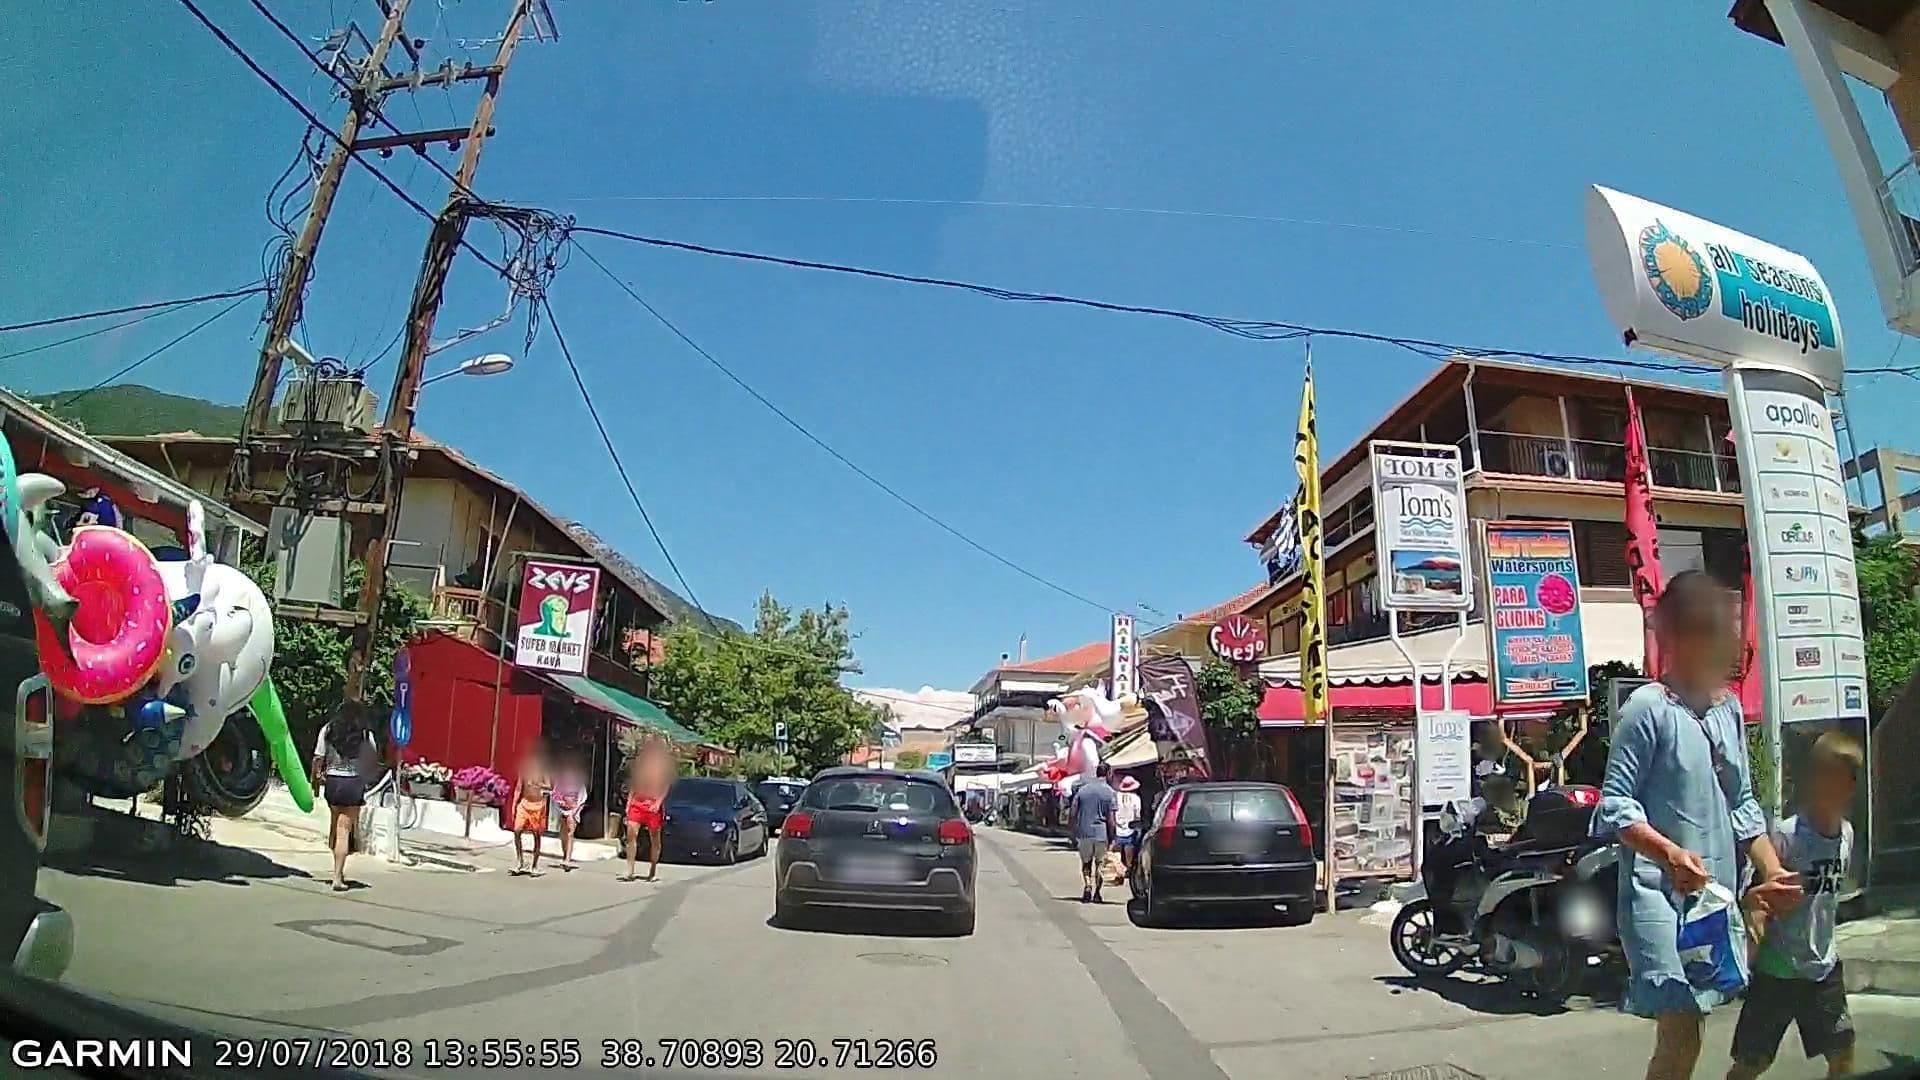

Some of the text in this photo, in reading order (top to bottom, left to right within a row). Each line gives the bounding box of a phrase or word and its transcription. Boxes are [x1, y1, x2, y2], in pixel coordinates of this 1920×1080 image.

[1709, 244, 1824, 304] all seasons
[1741, 291, 1819, 354] holidays
[1766, 402, 1820, 428] apollo
[1392, 486, 1453, 518] Tom's
[1491, 560, 1573, 573] Watersports
[1495, 587, 1525, 604] PARA
[1496, 610, 1544, 628] GLIDING
[549, 640, 582, 656] MARKET
[1211, 625, 1265, 661] Fuego
